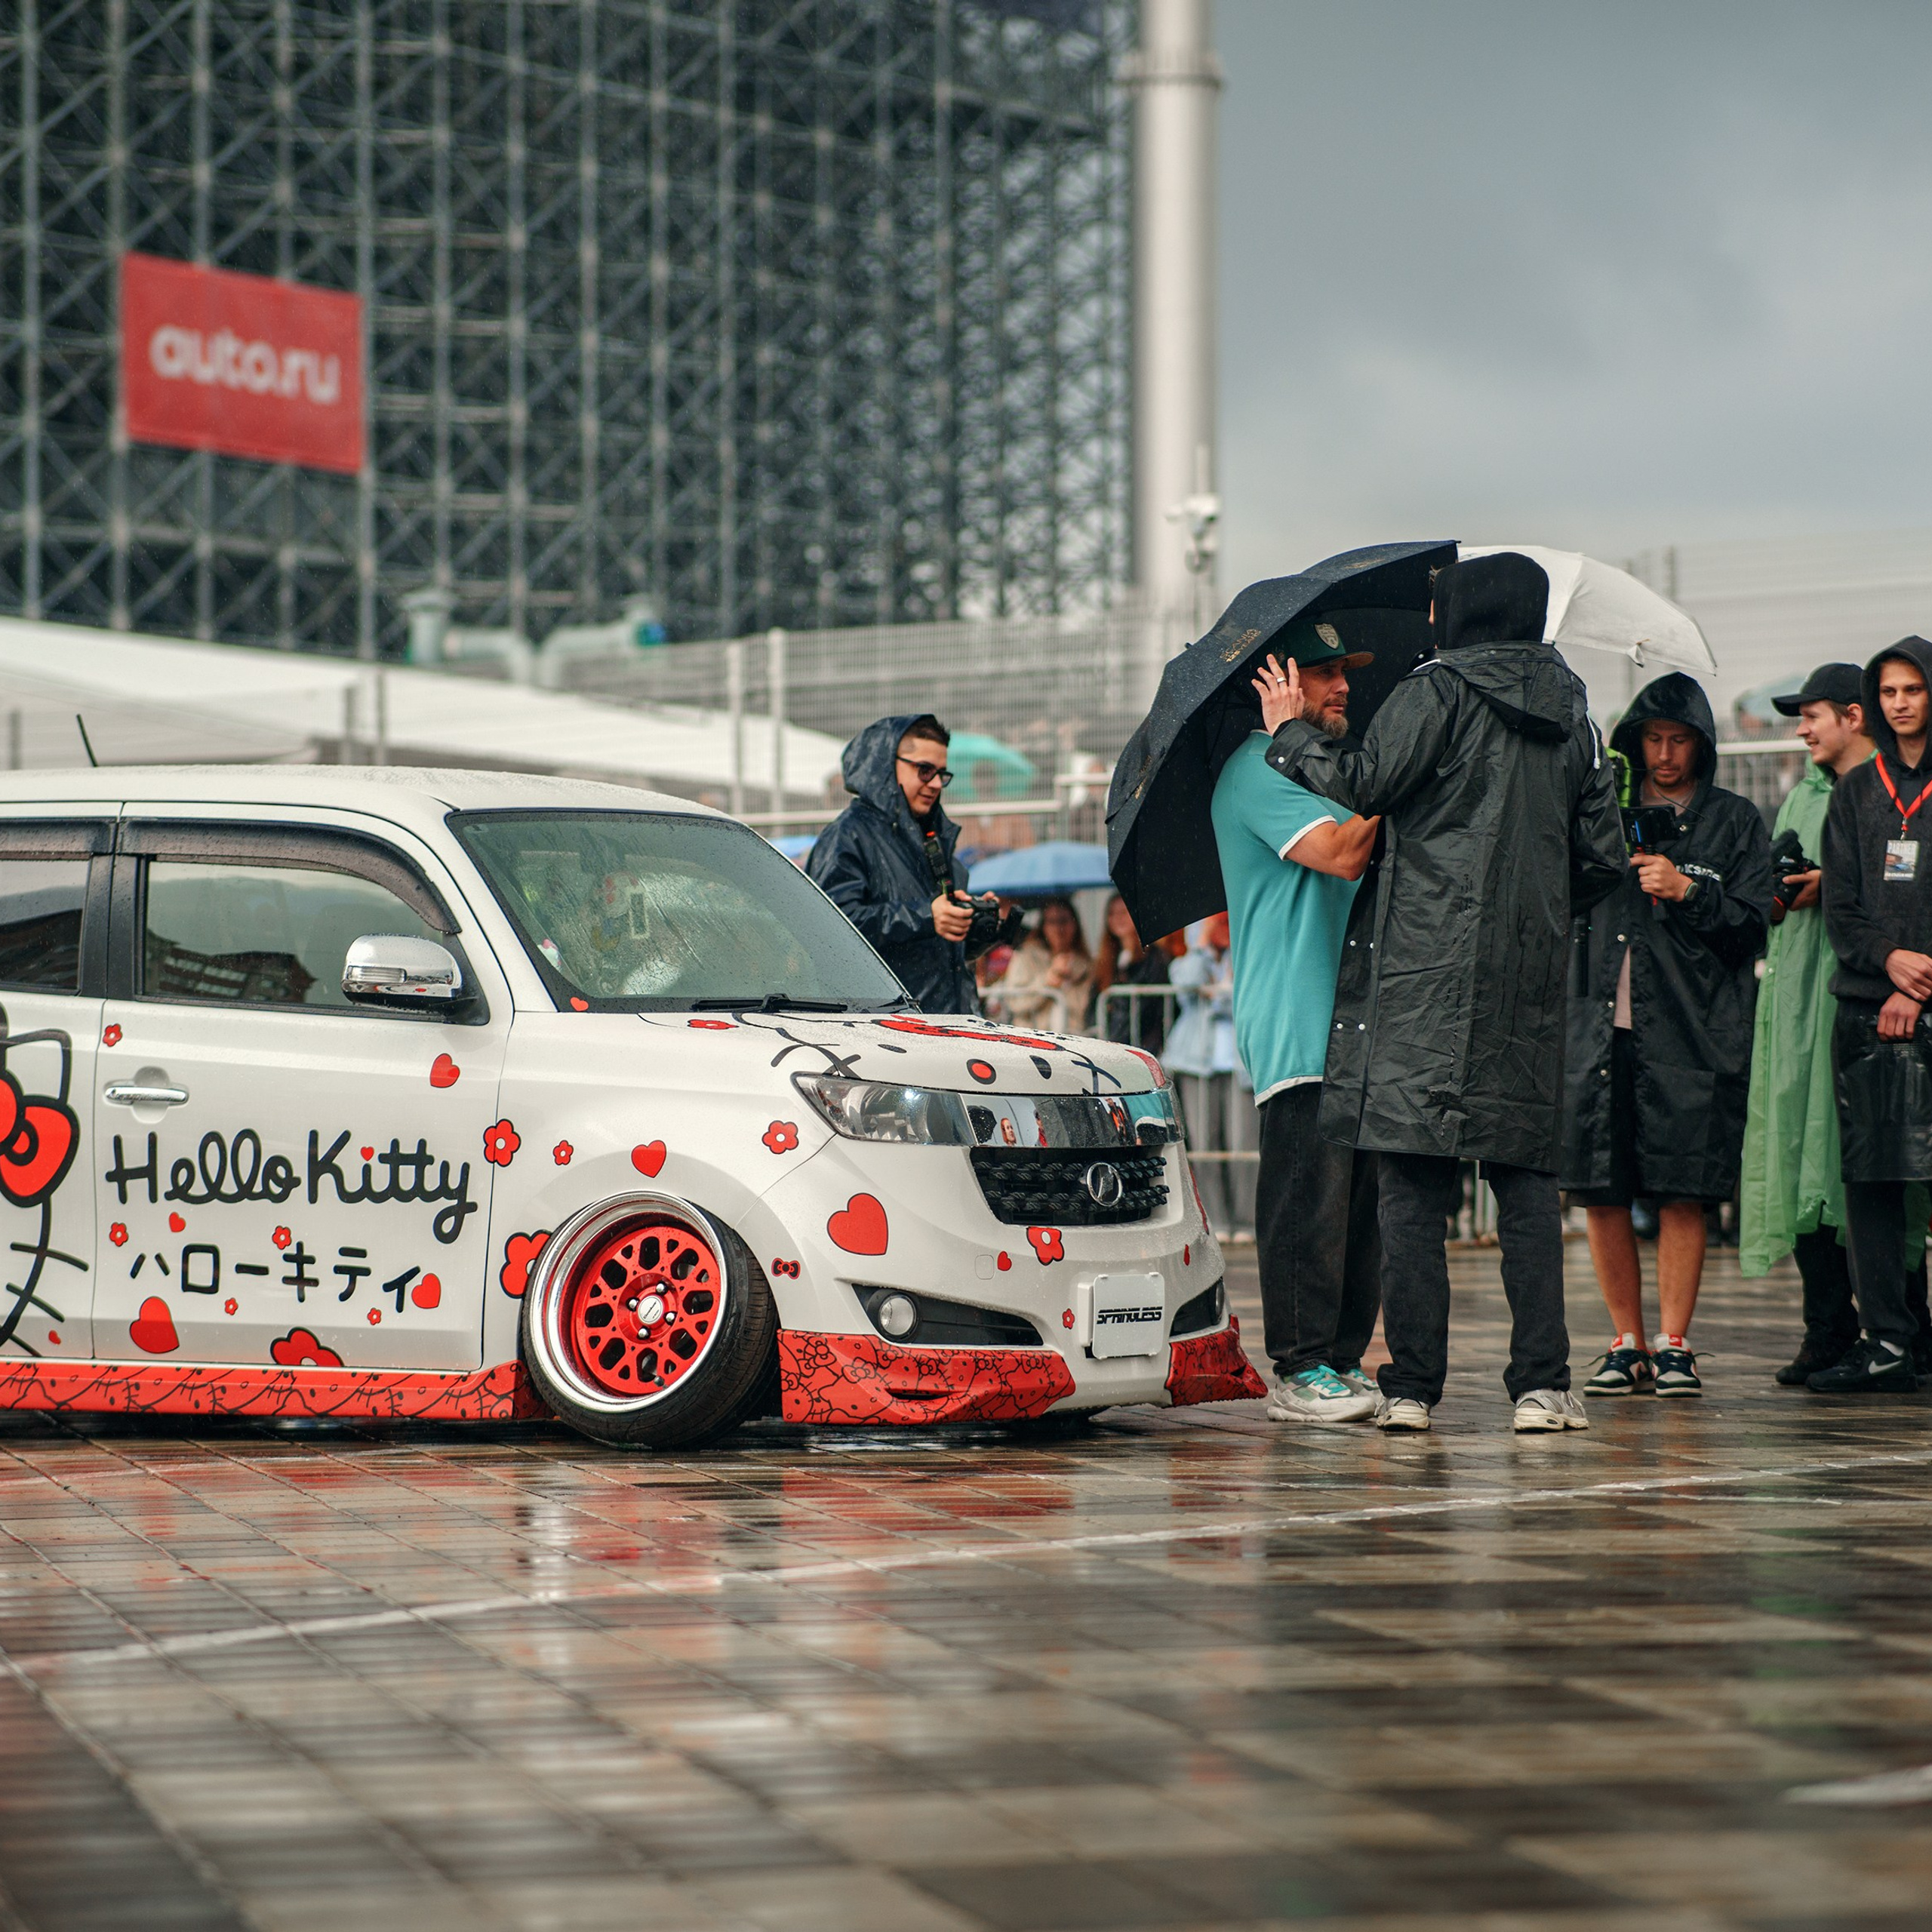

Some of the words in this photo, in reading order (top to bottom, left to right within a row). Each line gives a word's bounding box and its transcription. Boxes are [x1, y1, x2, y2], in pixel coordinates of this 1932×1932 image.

[150, 325, 340, 405] auto.ru
[105, 1128, 302, 1205] Hello
[307, 1129, 478, 1244] Kitty
[130, 1241, 421, 1314] ハローキティ
[1097, 1306, 1163, 1324] SPRINGLESS
